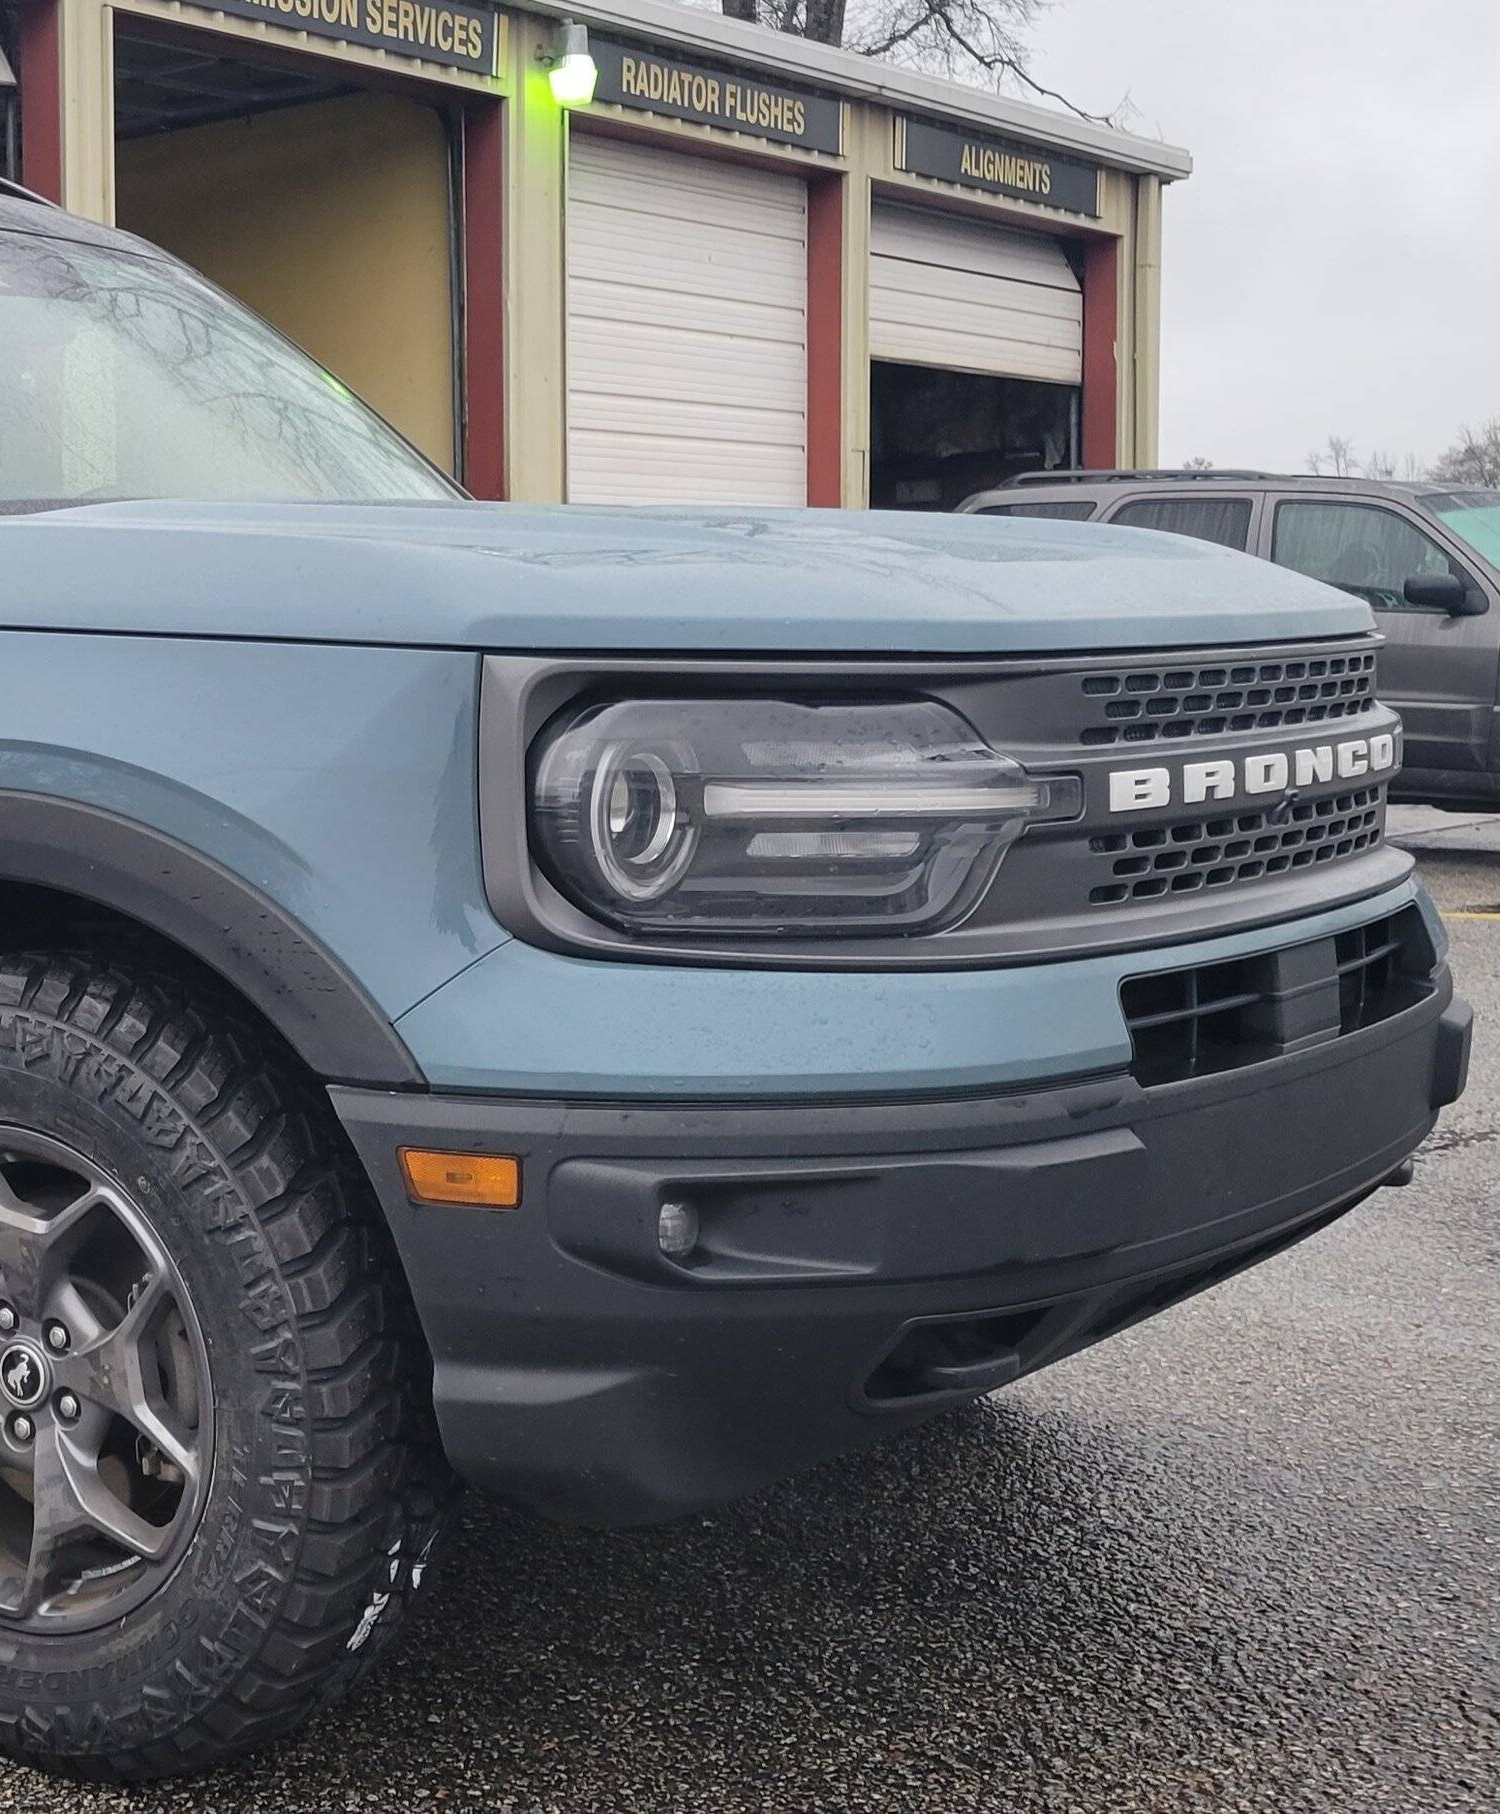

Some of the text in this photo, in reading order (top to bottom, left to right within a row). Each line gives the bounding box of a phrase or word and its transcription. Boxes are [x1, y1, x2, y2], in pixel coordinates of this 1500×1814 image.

[365, 0, 482, 59] SERVICES
[621, 56, 805, 136] RADIATOR FLUSHES
[961, 144, 1051, 195] ALIGNMENTS
[1108, 733, 1393, 813] BRONCO
